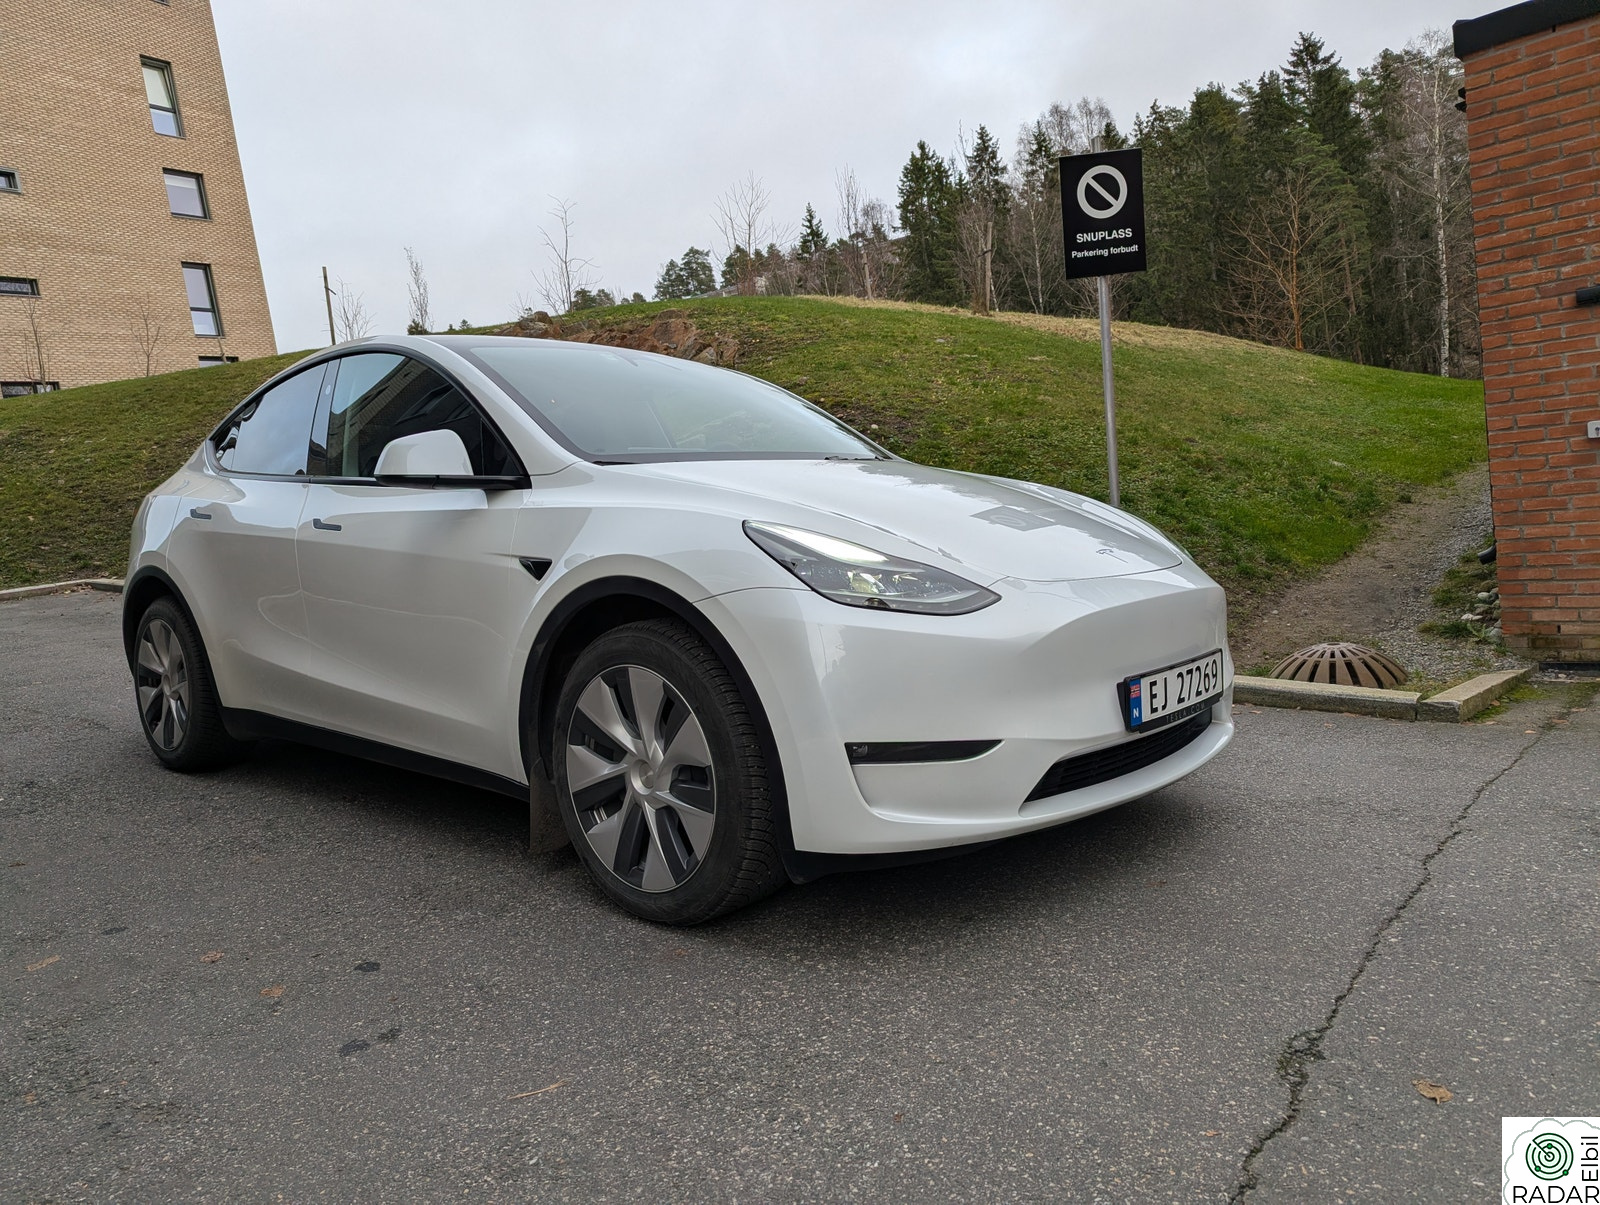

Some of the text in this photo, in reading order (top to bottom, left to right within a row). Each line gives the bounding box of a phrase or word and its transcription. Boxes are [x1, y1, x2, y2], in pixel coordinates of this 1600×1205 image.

[1076, 228, 1133, 243] SNUPLASS
[1071, 244, 1139, 259] Parkering forbudt
[1149, 659, 1218, 714] EJ 27269
[1133, 707, 1139, 718] N
